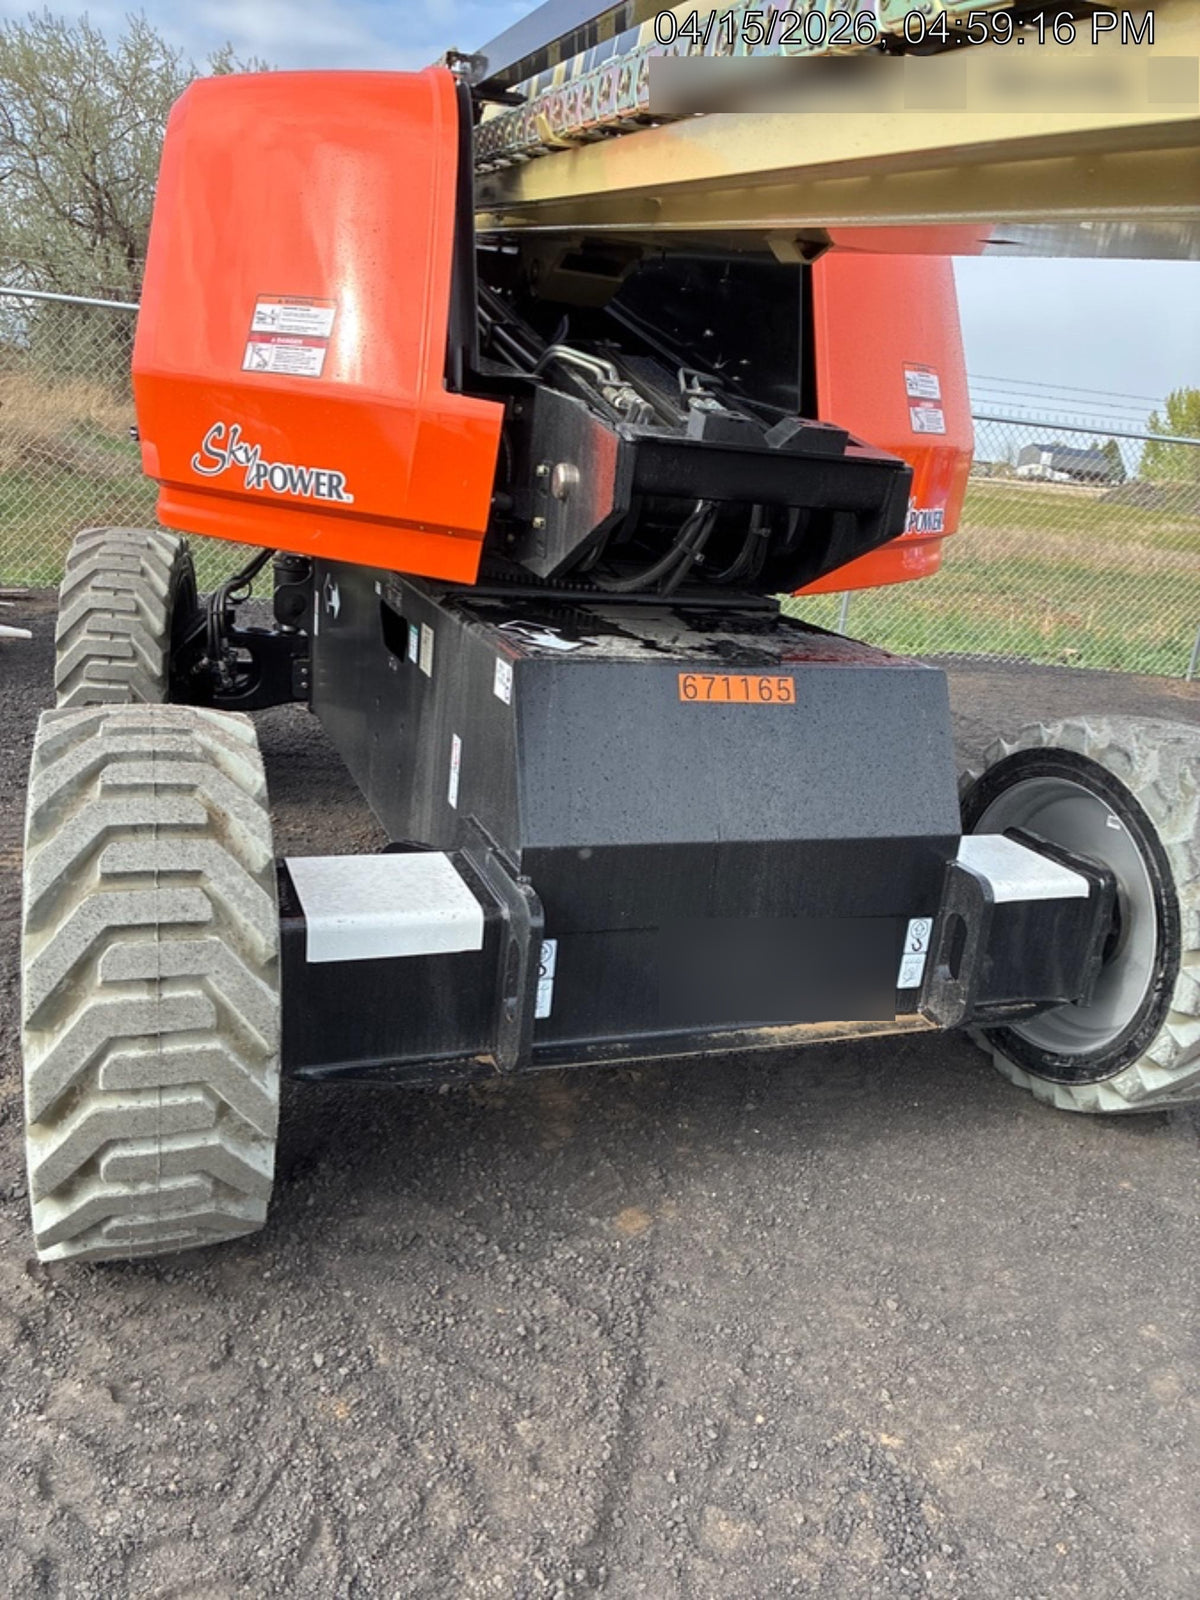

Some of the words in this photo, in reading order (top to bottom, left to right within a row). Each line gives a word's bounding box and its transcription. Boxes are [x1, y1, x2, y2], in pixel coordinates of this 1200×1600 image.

[191, 421, 262, 489] Sky
[254, 461, 348, 501] POWER
[682, 675, 791, 701] 671165
